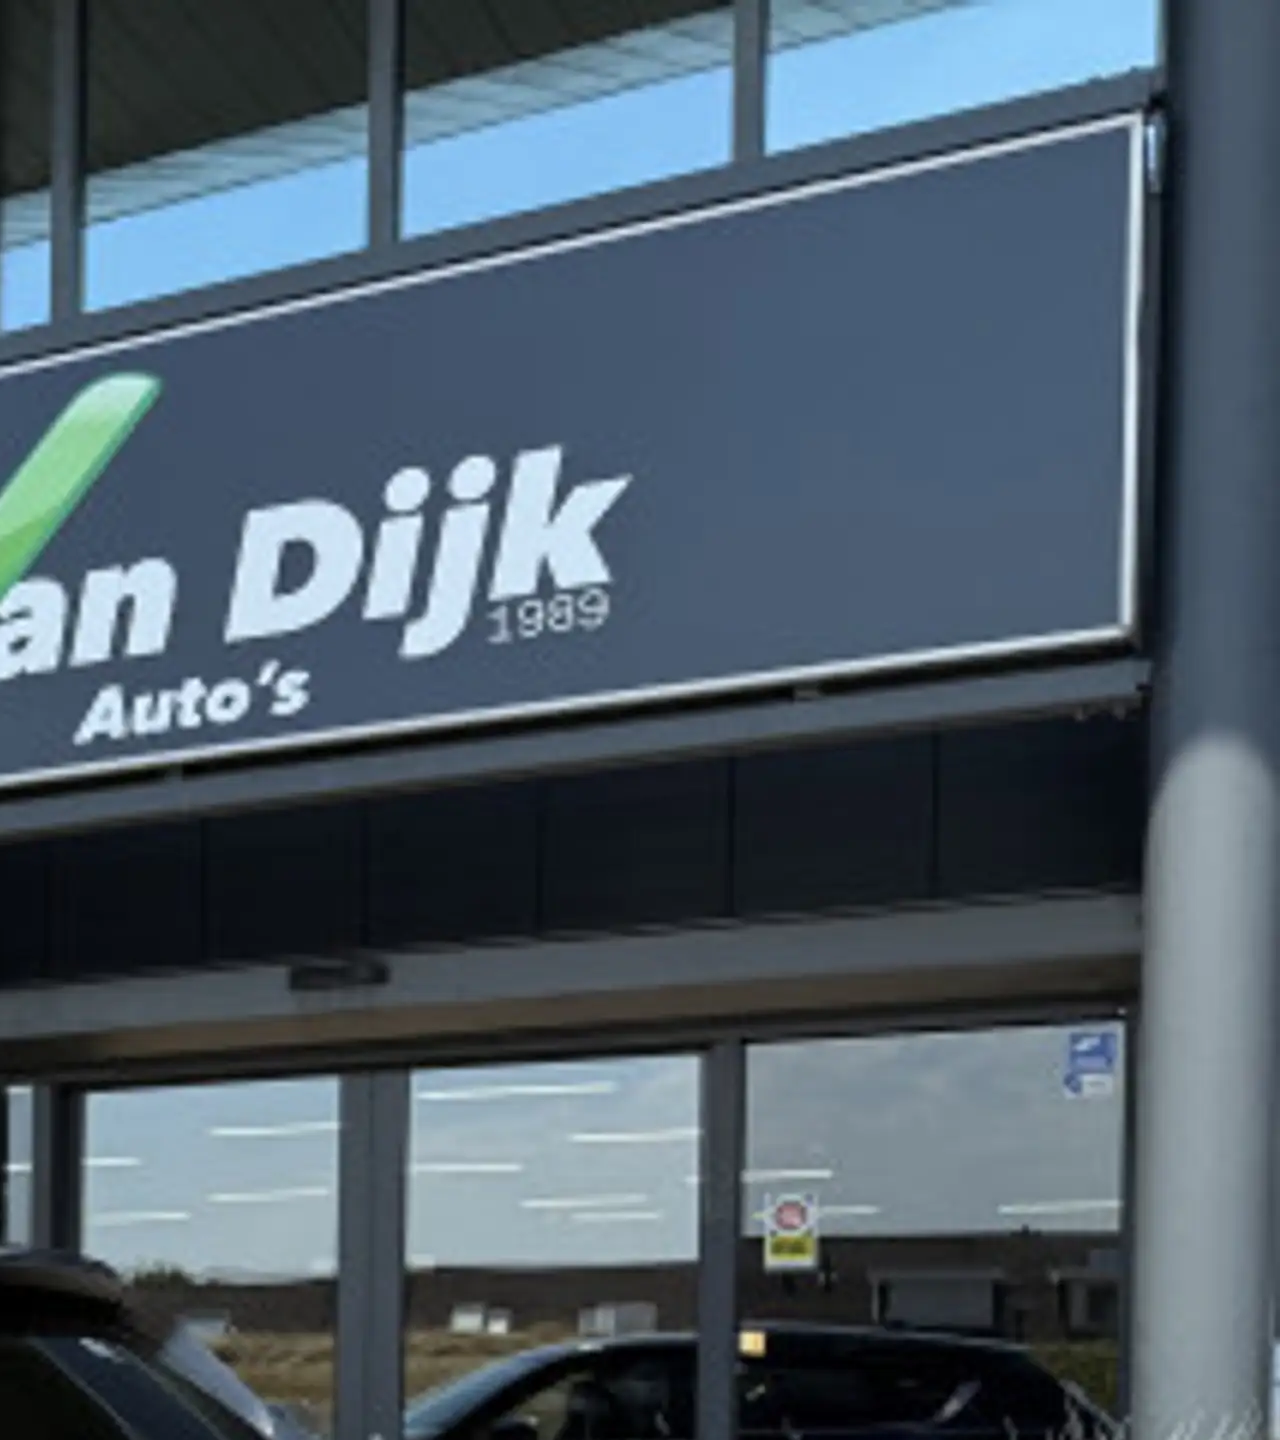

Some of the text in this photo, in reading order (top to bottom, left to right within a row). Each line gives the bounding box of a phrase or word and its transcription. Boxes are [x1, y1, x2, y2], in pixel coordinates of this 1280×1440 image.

[224, 444, 633, 659] Dijk
[486, 587, 612, 645] 1989
[72, 658, 310, 746] Auto's
